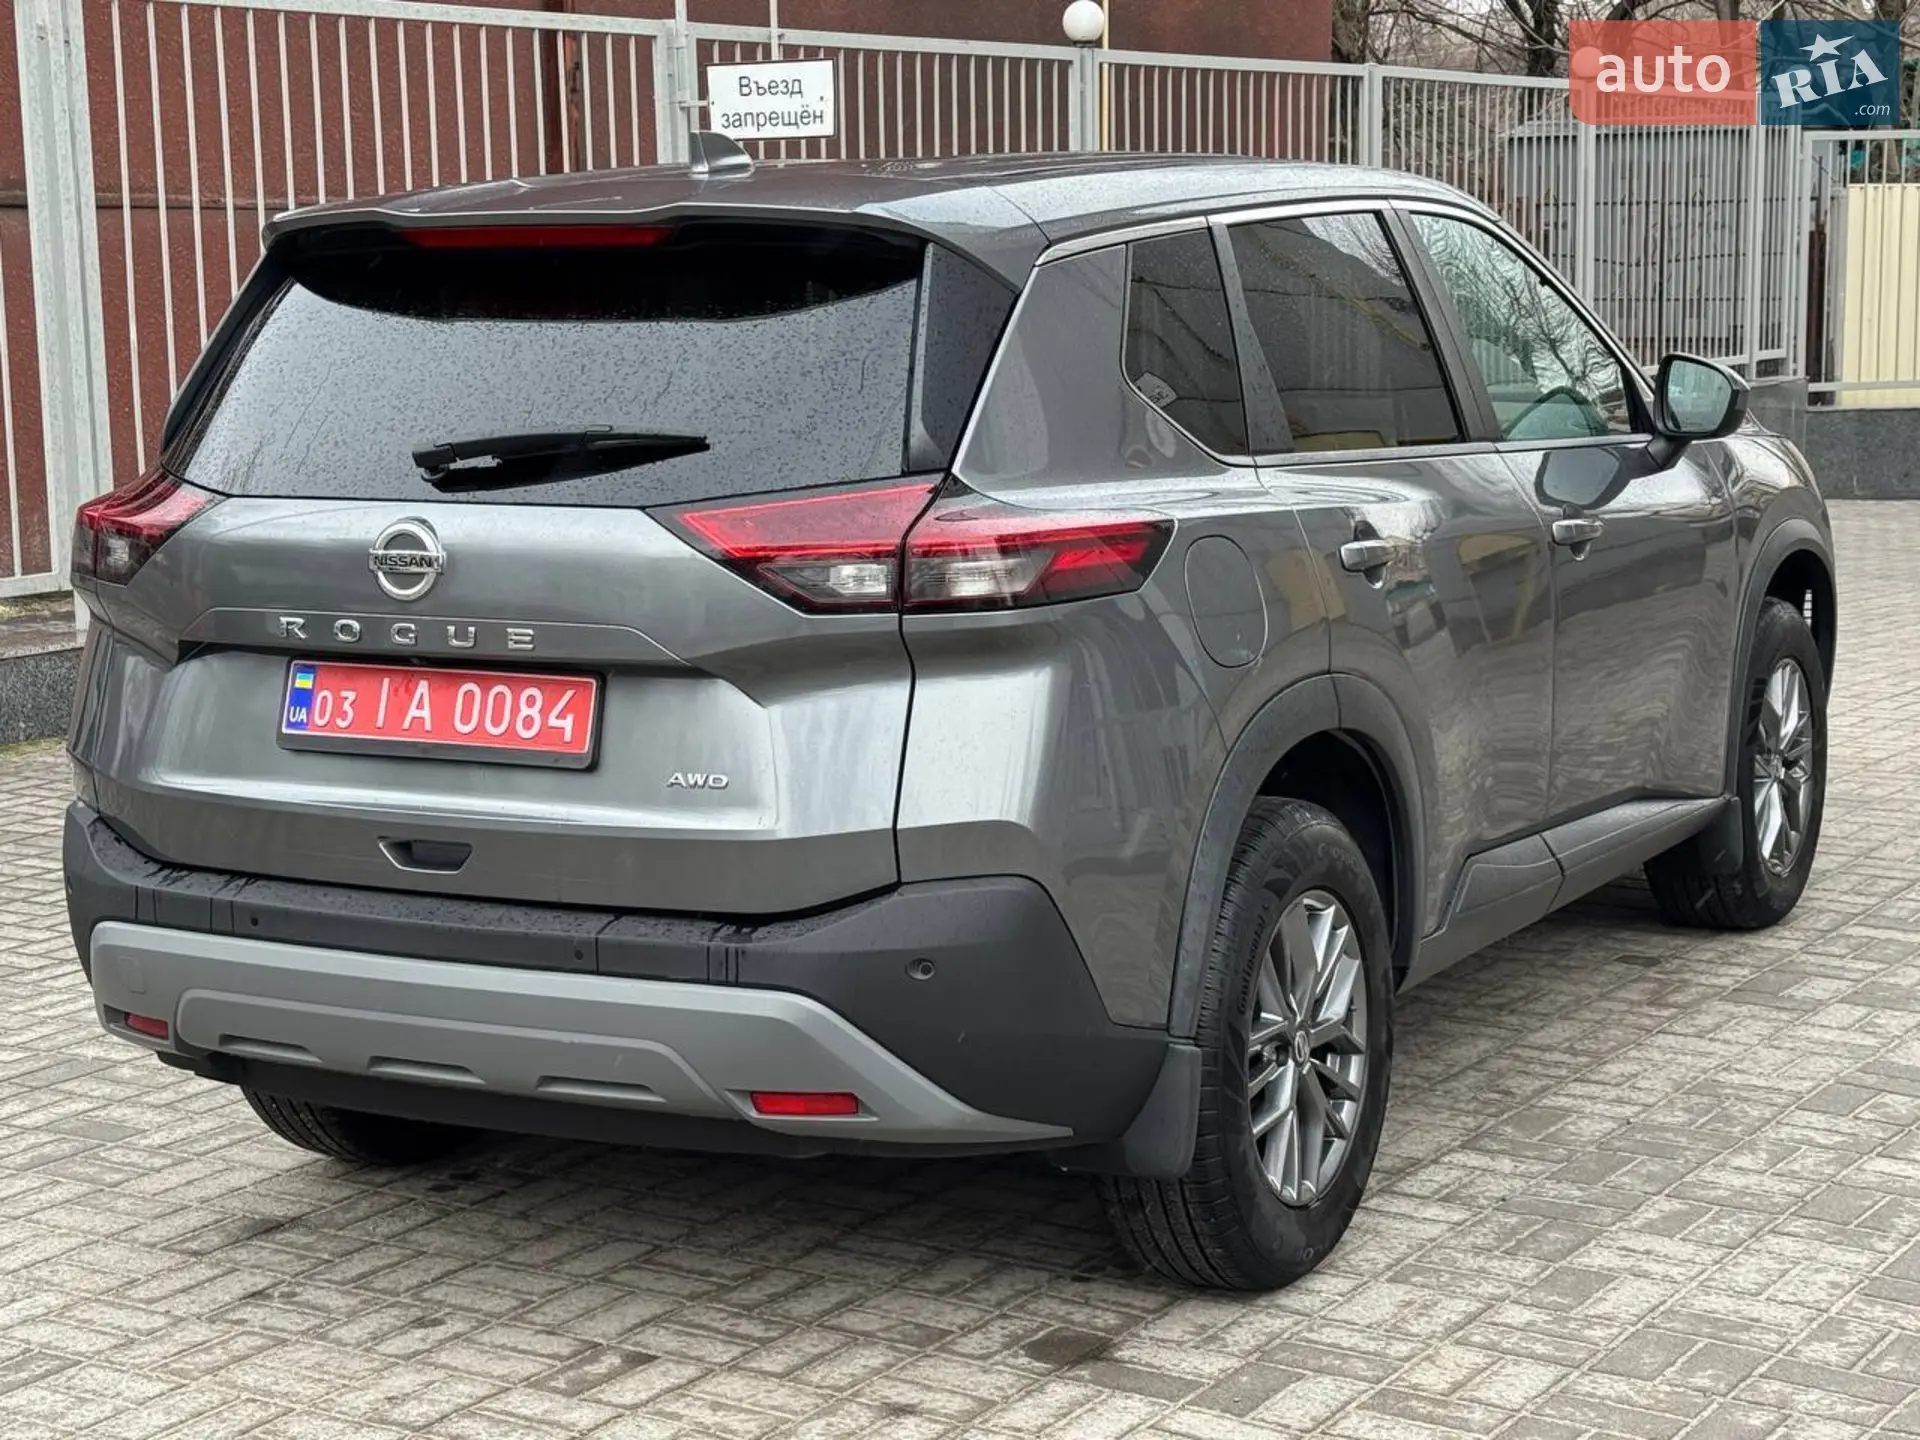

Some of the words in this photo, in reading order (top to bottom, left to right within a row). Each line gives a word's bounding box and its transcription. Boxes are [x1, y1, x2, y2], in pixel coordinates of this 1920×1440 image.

[738, 75, 804, 99] Въезд
[720, 104, 825, 132] запрещён
[373, 554, 433, 568] NISSAN
[278, 616, 536, 651] ROGUE
[289, 705, 308, 725] UA
[313, 688, 358, 729] 03
[453, 681, 576, 743] 0084
[666, 771, 730, 790] AWD
